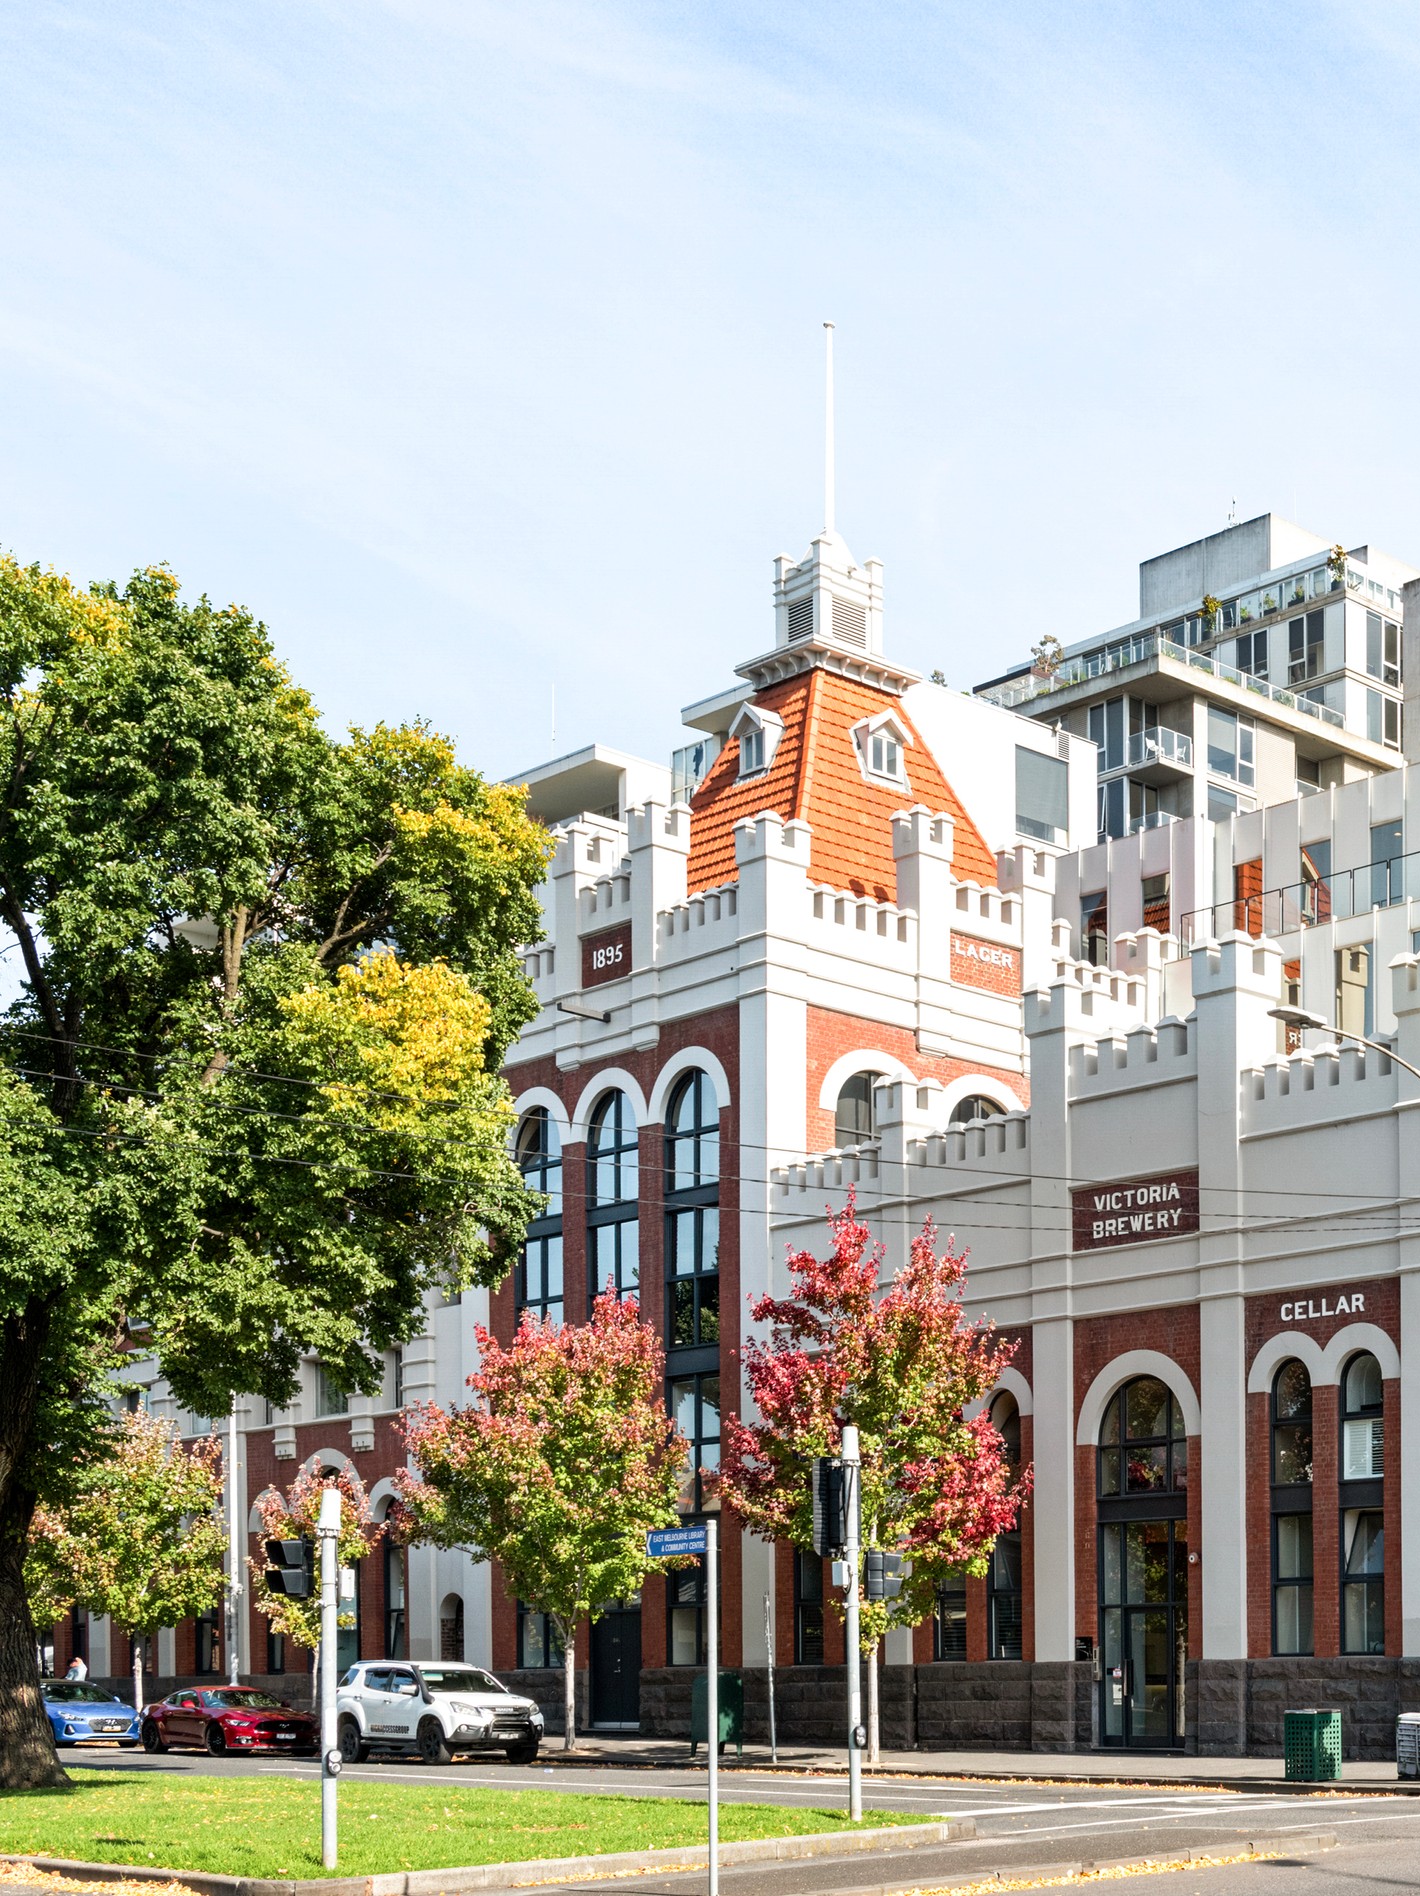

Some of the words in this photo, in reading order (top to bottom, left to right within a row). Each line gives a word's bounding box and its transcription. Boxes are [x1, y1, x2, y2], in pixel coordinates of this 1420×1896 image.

[593, 944, 623, 970] 1895
[1094, 1182, 1180, 1212] VICTORIA
[1093, 1208, 1182, 1239] BREWERY
[1281, 1293, 1365, 1322] CELLAR
[664, 1532, 688, 1542] MELBOURNE
[688, 1531, 705, 1540] LIBRARY
[665, 1543, 689, 1552] COMMUNITY
[689, 1541, 705, 1550] CENTRE
